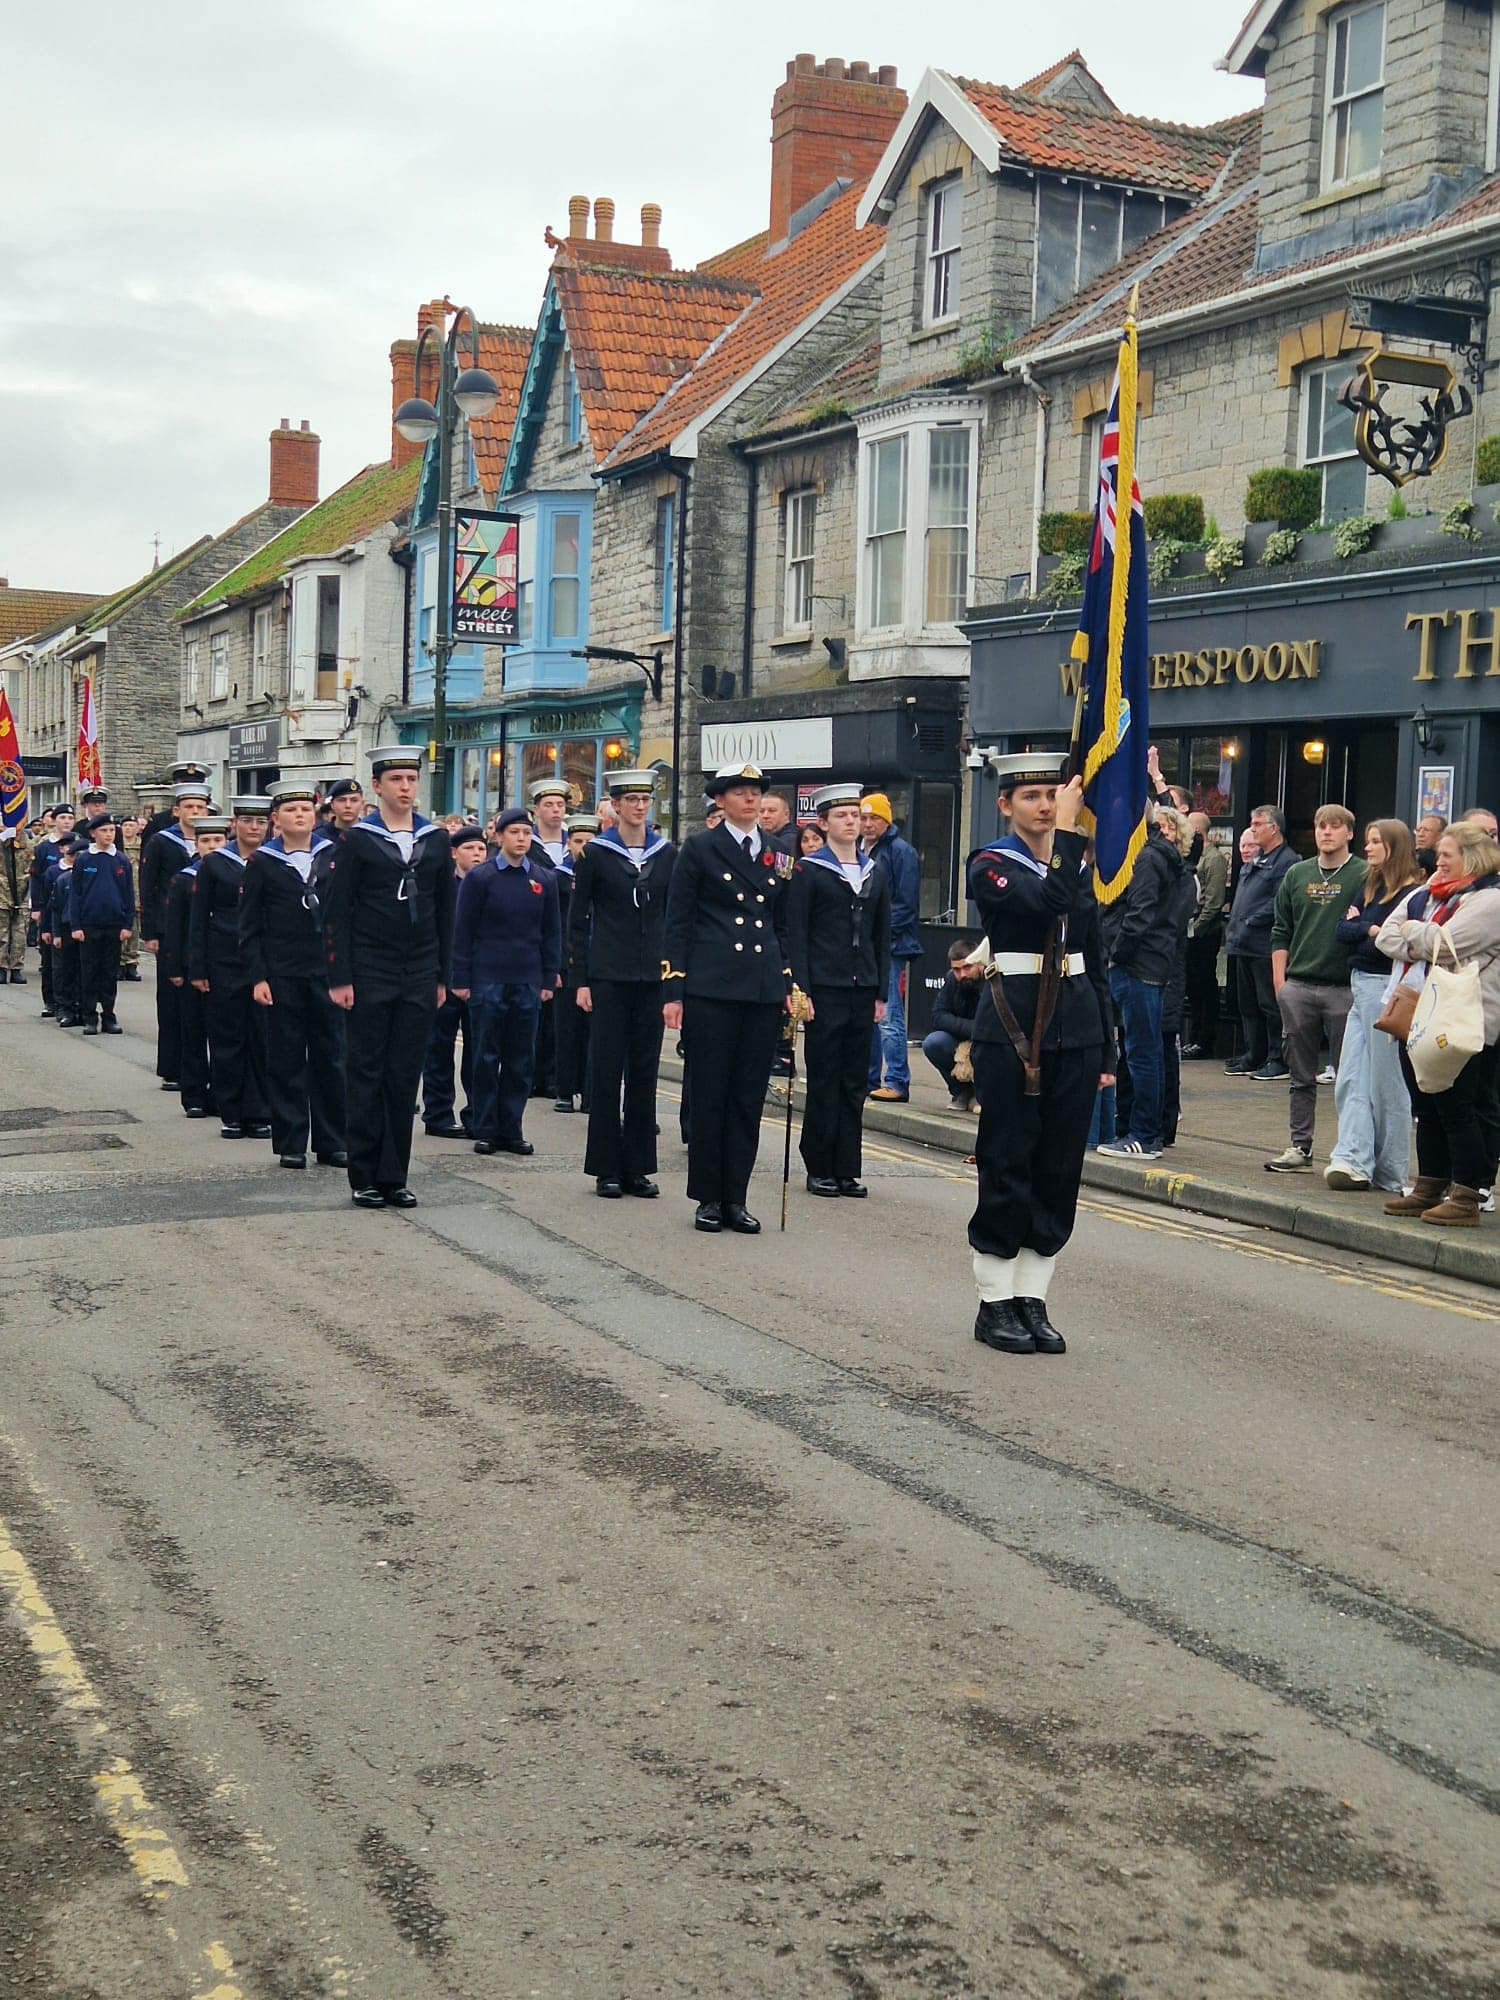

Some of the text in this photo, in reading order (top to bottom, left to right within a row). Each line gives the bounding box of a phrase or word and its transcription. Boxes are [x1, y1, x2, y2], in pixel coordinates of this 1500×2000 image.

[458, 607, 512, 621] meet
[457, 620, 514, 634] STREET
[1060, 639, 1323, 697] WERSPOON
